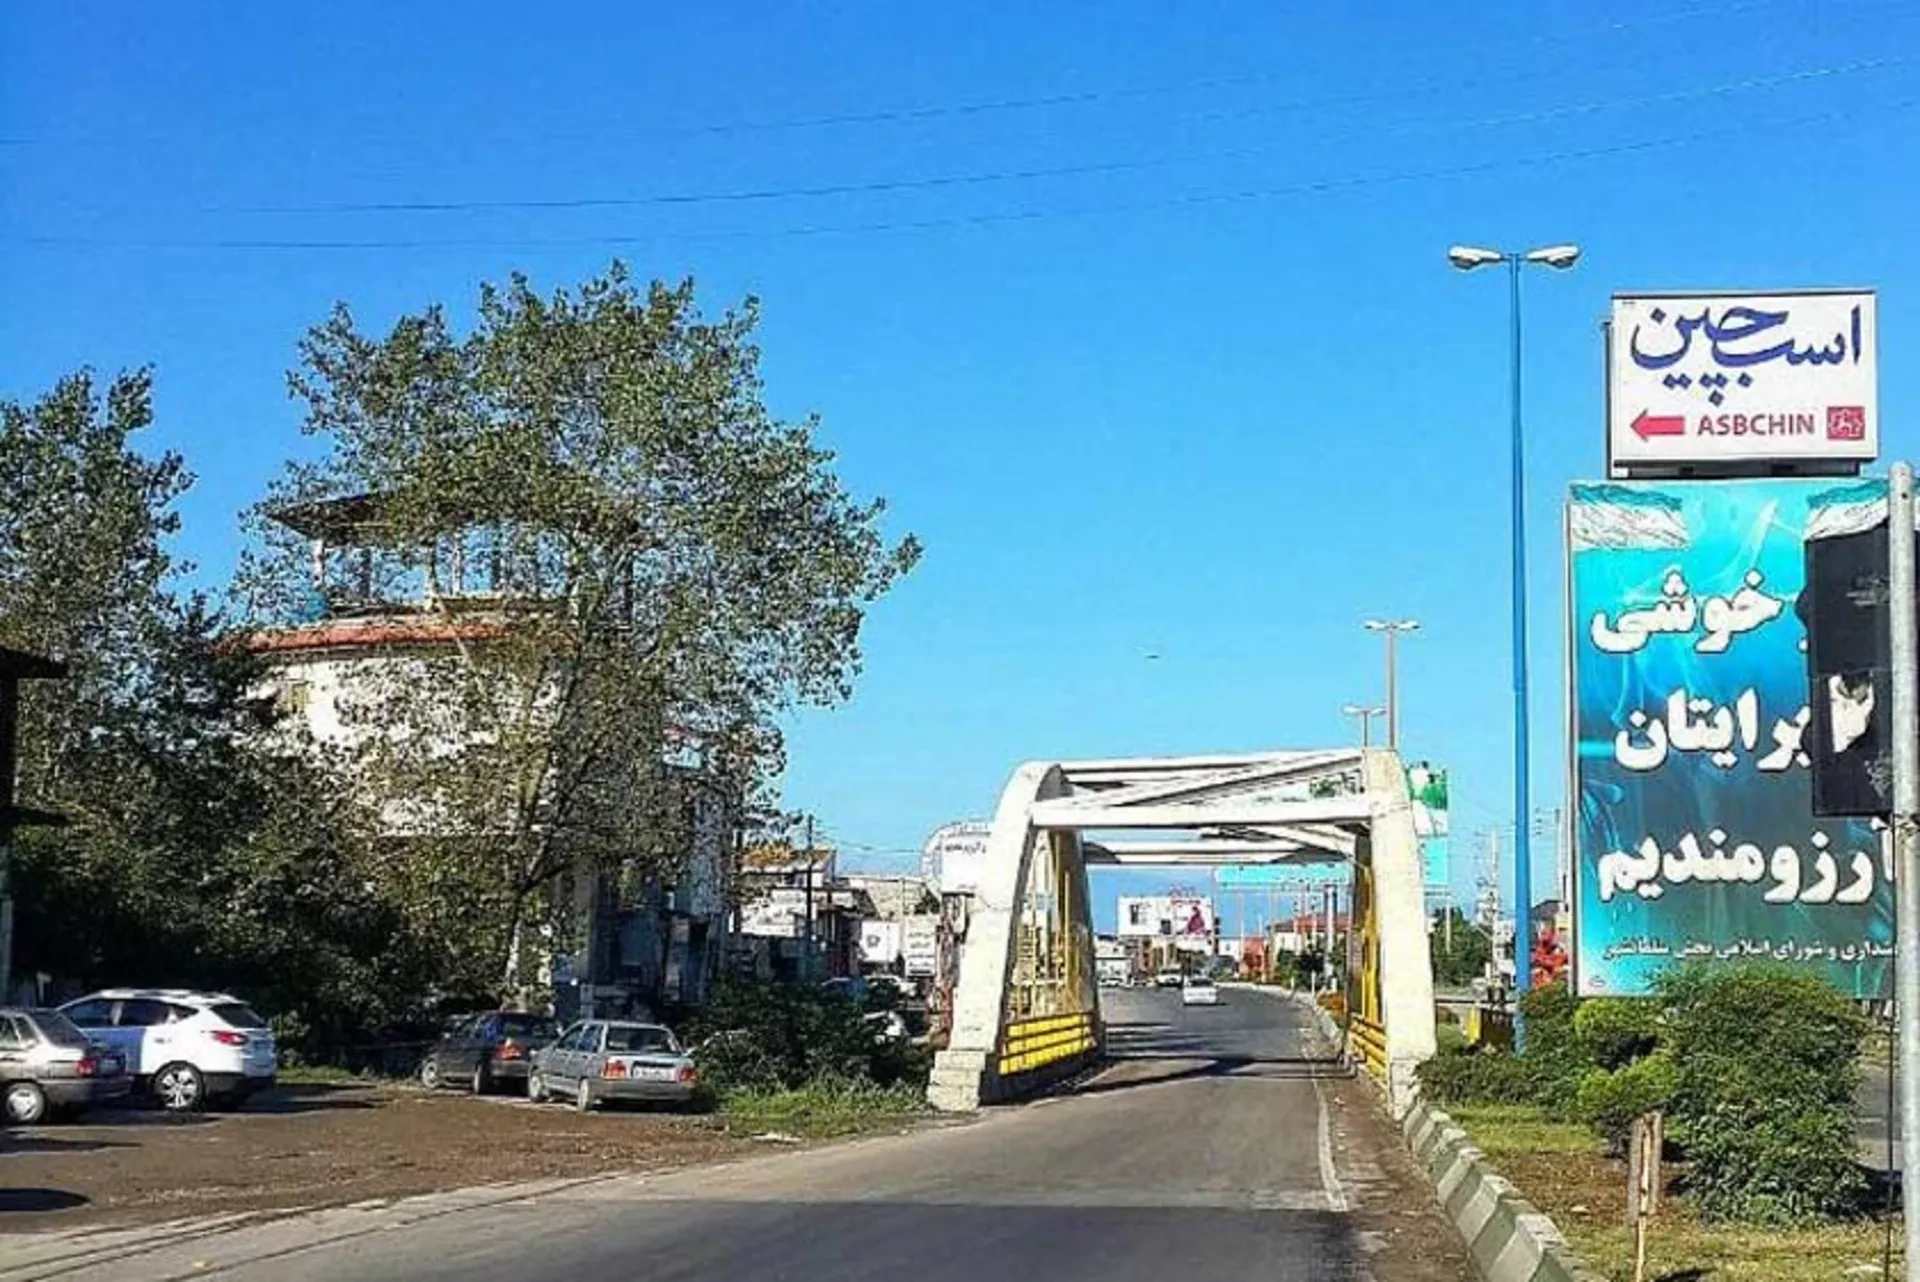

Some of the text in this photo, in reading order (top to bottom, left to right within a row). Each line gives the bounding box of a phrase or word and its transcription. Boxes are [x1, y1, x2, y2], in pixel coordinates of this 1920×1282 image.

[1697, 413, 1815, 436] ASBCHIN
[1591, 569, 1784, 653] خوشی
[1614, 687, 1812, 771] برایتان
